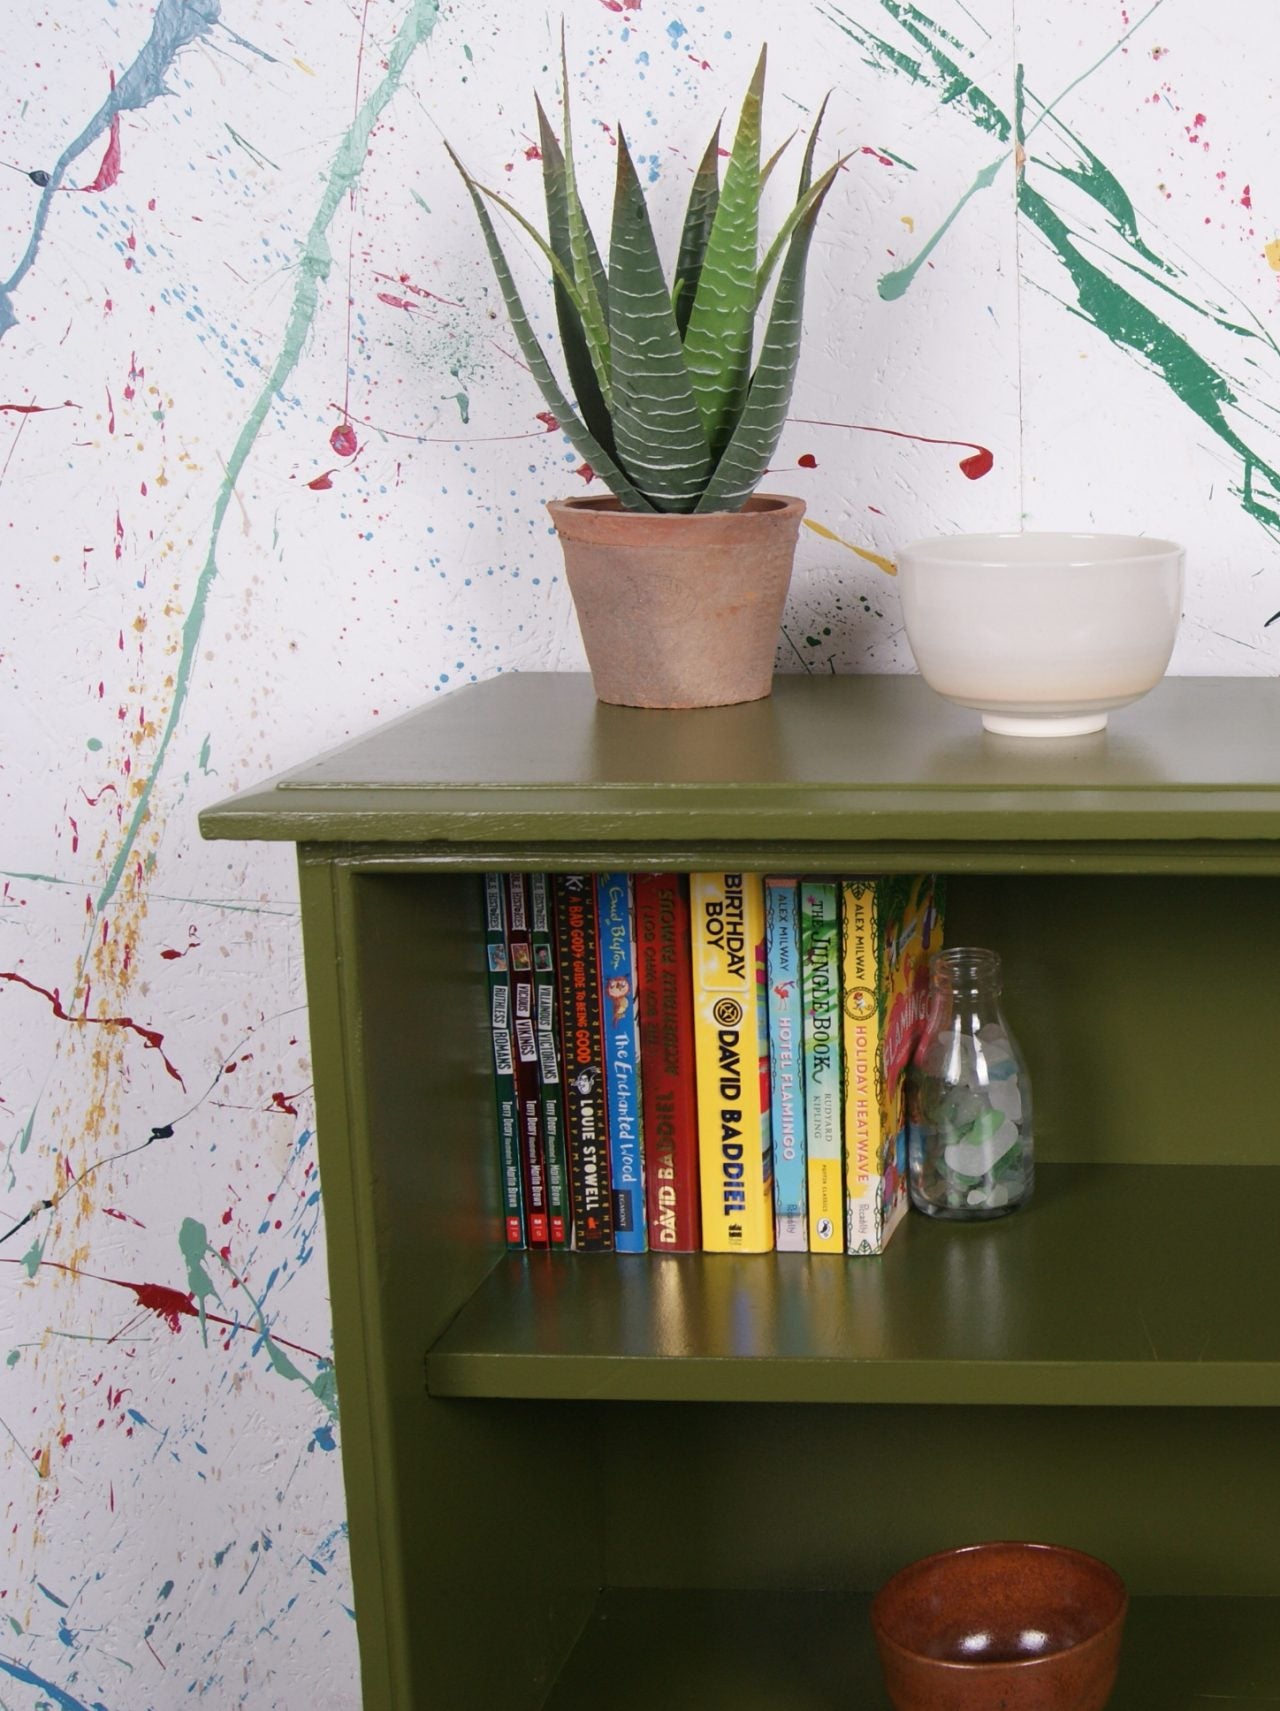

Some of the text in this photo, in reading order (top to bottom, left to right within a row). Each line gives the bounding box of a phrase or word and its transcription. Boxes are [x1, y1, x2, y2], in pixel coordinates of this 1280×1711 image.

[566, 876, 584, 892] Ki
[568, 905, 584, 928] BAD
[608, 887, 626, 970] Enid Blyton
[658, 889, 676, 964] FAMOUS
[705, 901, 724, 951] BOY
[724, 873, 746, 980] BIRTHDAY
[778, 893, 790, 972] ALEX MILWAY
[853, 904, 866, 981] ALEX MILWAY
[573, 961, 586, 988] GUIDE
[811, 901, 832, 1083] THE JUNGLE BOOK
[494, 987, 510, 1070] RUTHLESS ROMANS
[518, 985, 535, 1056] VICIOUS VIKINGS
[539, 987, 557, 1080] VILLAINOUS VICTORIANS
[576, 1002, 588, 1028] BEING
[576, 1030, 591, 1063] GOOD
[717, 1030, 742, 1101] DAVID
[778, 1018, 795, 1161] HOTEL FLAMINGO
[502, 1101, 513, 1117] Terry
[526, 1100, 537, 1116] Terry
[545, 1099, 557, 1115] Terry
[580, 1099, 596, 1140] LOUIE
[614, 1031, 637, 1182] The Enchanted Wood
[813, 1096, 822, 1139] KIPLING
[824, 1093, 833, 1142] RUDYARD
[855, 1025, 869, 1182] HOLIDAY HEATWAVE
[583, 1146, 599, 1211] STOWELL
[656, 1092, 677, 1244] DAVID BADDIEL
[720, 1110, 746, 1216] BADDIEL
